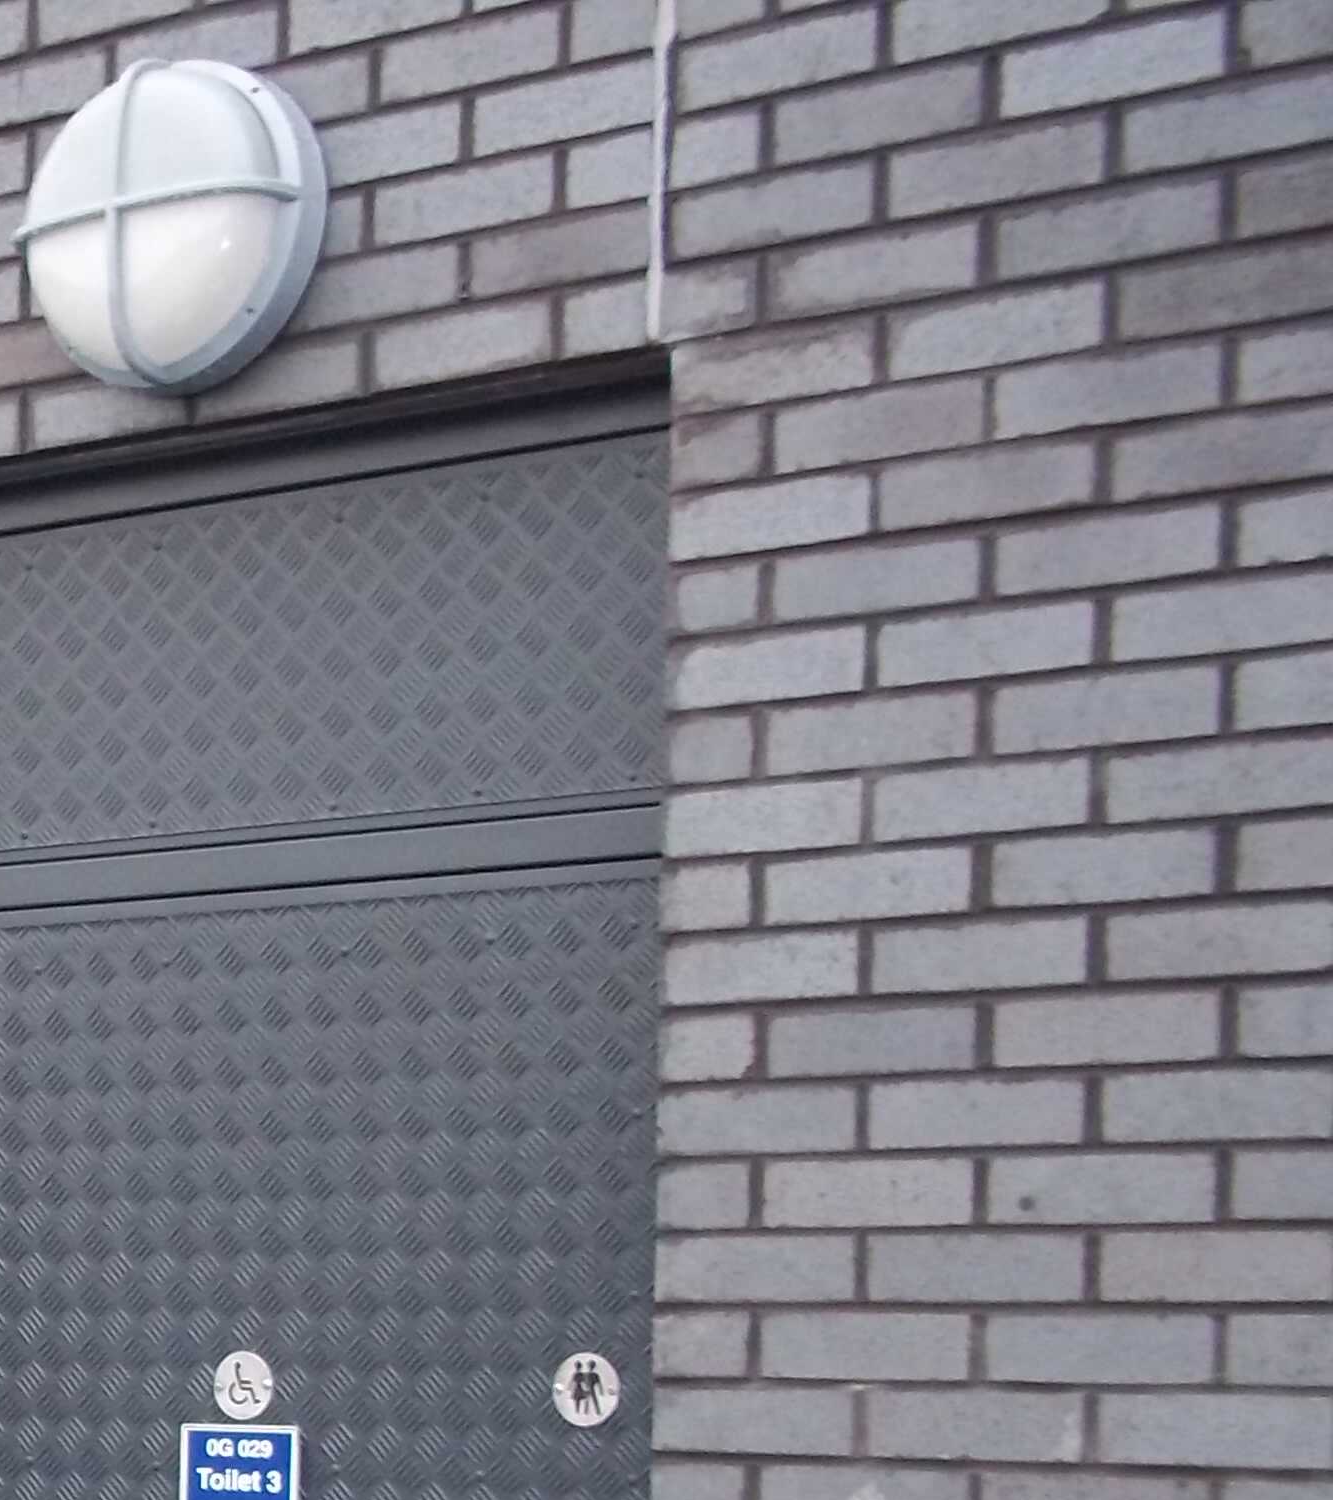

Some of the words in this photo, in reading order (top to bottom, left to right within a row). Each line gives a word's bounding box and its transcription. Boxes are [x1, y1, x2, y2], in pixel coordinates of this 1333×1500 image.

[237, 1439, 274, 1459] 029
[196, 1467, 262, 1492] Toilet
[265, 1470, 283, 1494] 3
